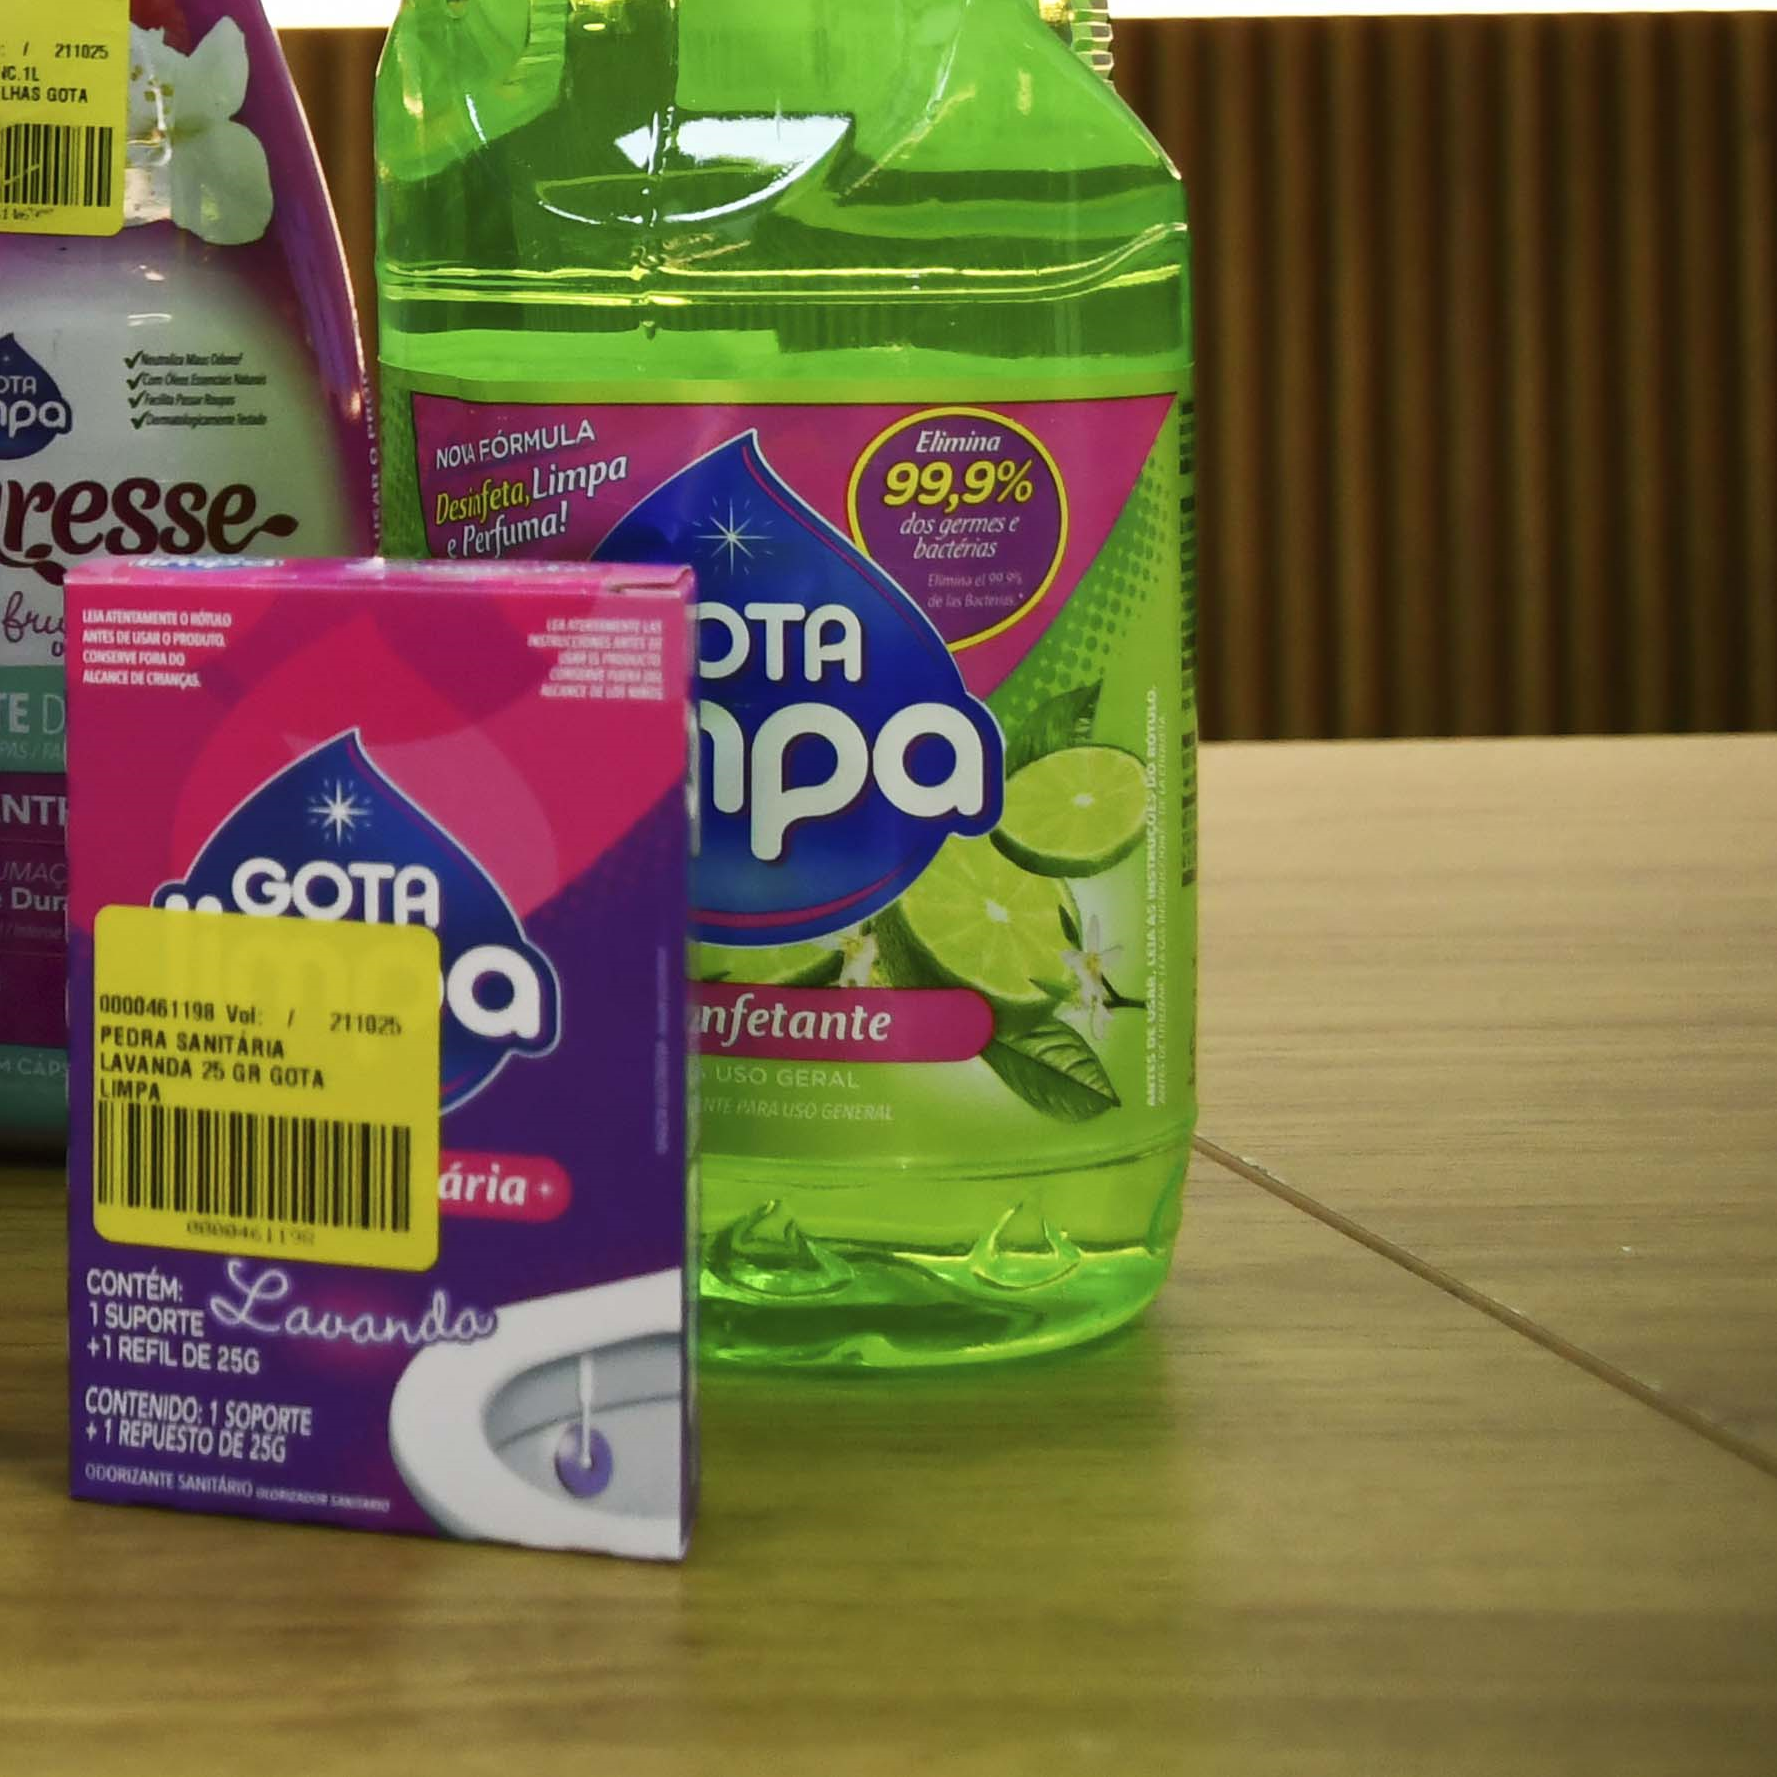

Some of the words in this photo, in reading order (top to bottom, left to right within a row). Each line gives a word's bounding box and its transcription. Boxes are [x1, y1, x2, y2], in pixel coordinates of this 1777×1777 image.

[55, 44, 108, 60] 211025
[47, 87, 88, 104] GOTA
[436, 443, 475, 470] NOVA
[479, 419, 595, 462] FÓRMULA
[915, 430, 1001, 453] Elimina
[436, 479, 531, 525] Desinfeta,
[532, 455, 627, 497] Limpa
[883, 459, 1033, 513] 99,9%
[447, 538, 457, 559] e
[462, 500, 568, 559] Perfuma!
[900, 511, 933, 535] dos
[935, 516, 1005, 541] germes
[1009, 515, 1020, 532] e
[913, 536, 998, 560] bactérias
[83, 608, 105, 624] LEIA
[106, 609, 177, 626] ATENTAMENTE
[180, 611, 189, 626] O
[190, 611, 231, 628] RÓTULO
[83, 630, 114, 646] ANTES
[116, 631, 131, 646] DE
[133, 632, 161, 647] USAR
[162, 632, 170, 647] O
[172, 631, 225, 649] PRODUTO.
[694, 603, 861, 682] OTA
[83, 650, 139, 666] CONSERVE
[141, 651, 167, 666] FORA
[170, 652, 185, 666] DO
[83, 669, 130, 686] ALCANCE
[131, 670, 146, 686] DE
[147, 670, 201, 690] CRIANÇAS.
[233, 859, 440, 928] GOTA
[99, 993, 215, 1022] 0000461198
[329, 1012, 402, 1037] 211025
[695, 993, 892, 1047] nfetante
[100, 1026, 168, 1051] PEDRA
[176, 1028, 285, 1059] SANITÁRIA
[99, 1055, 192, 1080] LAVANDA
[201, 1061, 226, 1081] 25
[233, 1064, 262, 1084] GR
[270, 1066, 325, 1091] GOTA
[99, 1078, 162, 1102] LIMPA
[716, 1066, 767, 1086] USO
[777, 1067, 860, 1089] GERAL
[87, 1266, 184, 1302] CONTÉM:
[209, 1257, 497, 1345] Lavanda
[89, 1303, 99, 1326] 1
[104, 1305, 205, 1338] SUPORTE
[118, 1337, 178, 1366] REFIL
[181, 1343, 211, 1371] DE
[217, 1345, 260, 1375] 25G
[85, 1386, 204, 1423] CONTENIDO:
[209, 1398, 219, 1421] 1
[224, 1401, 312, 1436] SOPORTE
[102, 1420, 112, 1445] 1
[118, 1420, 214, 1455] REPUESTO
[218, 1428, 244, 1459] DE
[248, 1431, 286, 1463] 25G
[85, 1463, 175, 1490] ODORIZANTE
[178, 1469, 253, 1499] SANITÁRIO
